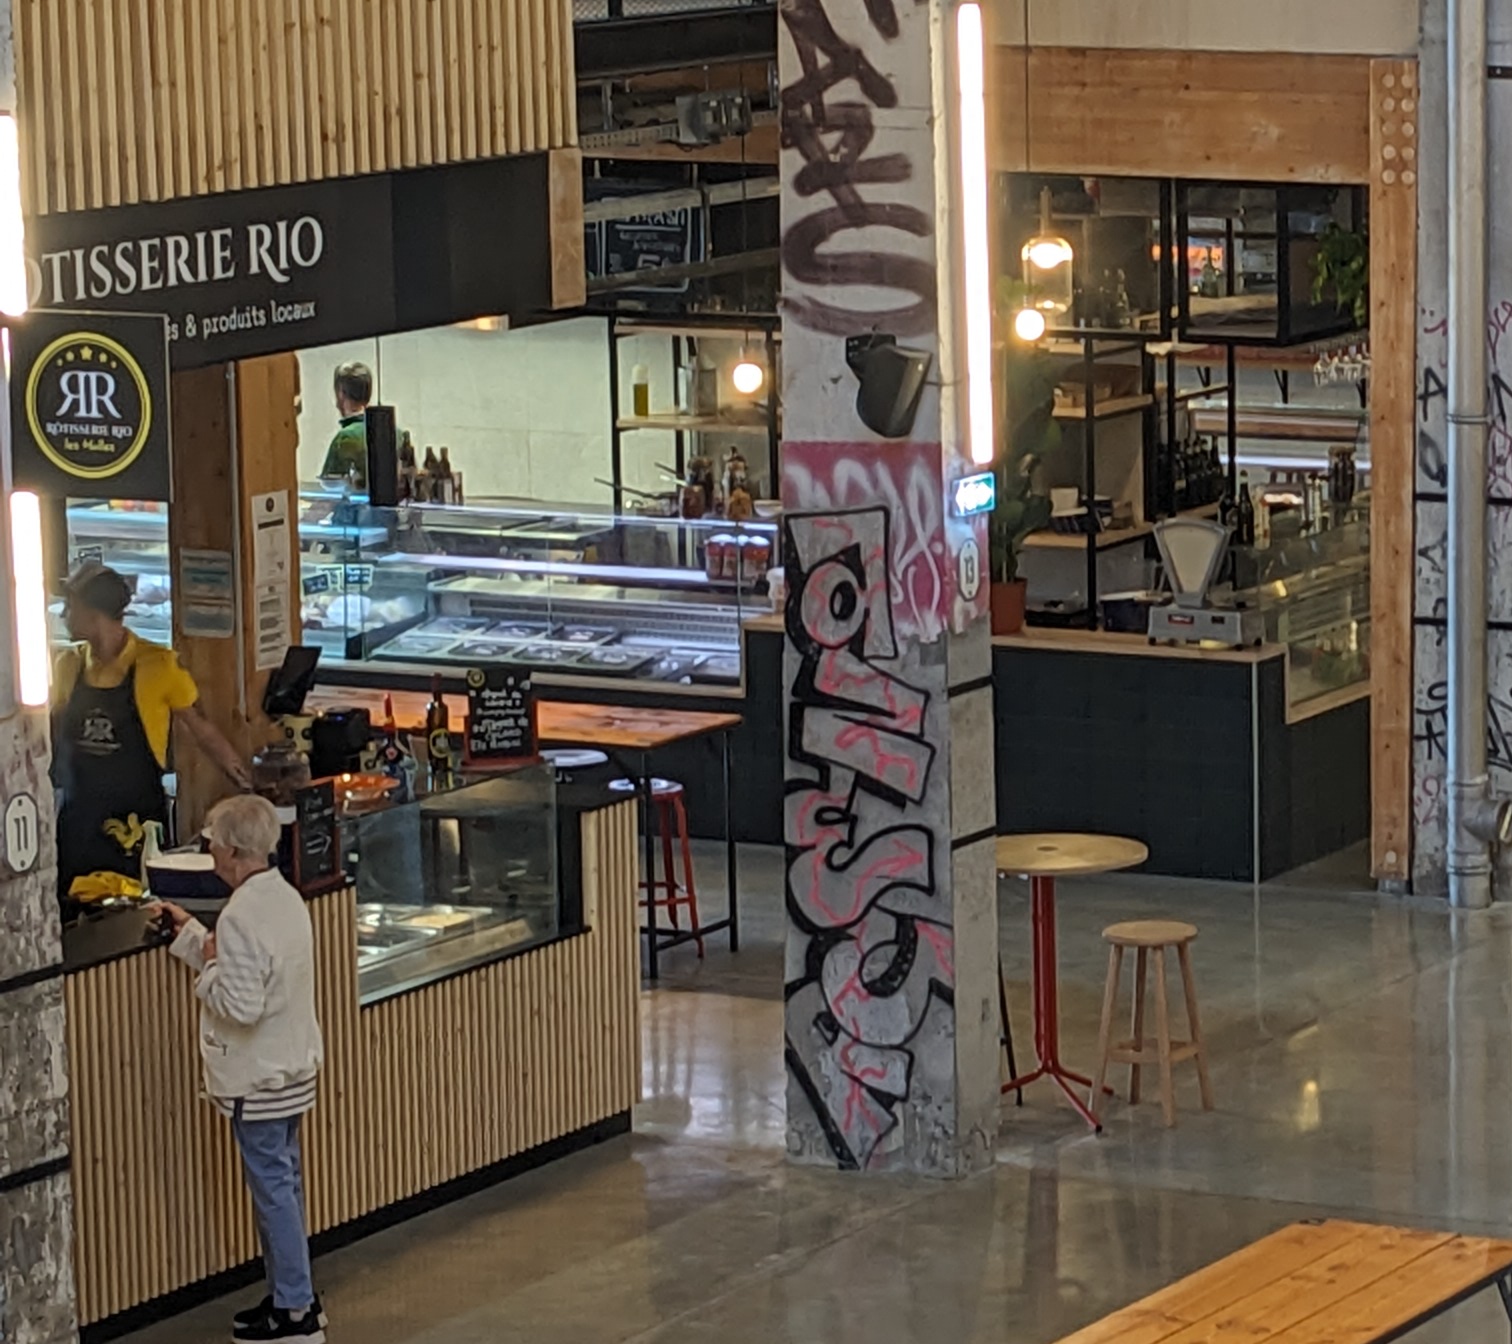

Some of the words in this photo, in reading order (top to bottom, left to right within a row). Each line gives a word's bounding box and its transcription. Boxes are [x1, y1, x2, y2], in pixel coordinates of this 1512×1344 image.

[247, 215, 324, 284] RIO
[184, 313, 198, 338] &
[202, 305, 267, 341] produits
[269, 299, 316, 324] locaux
[13, 814, 29, 853] 11
